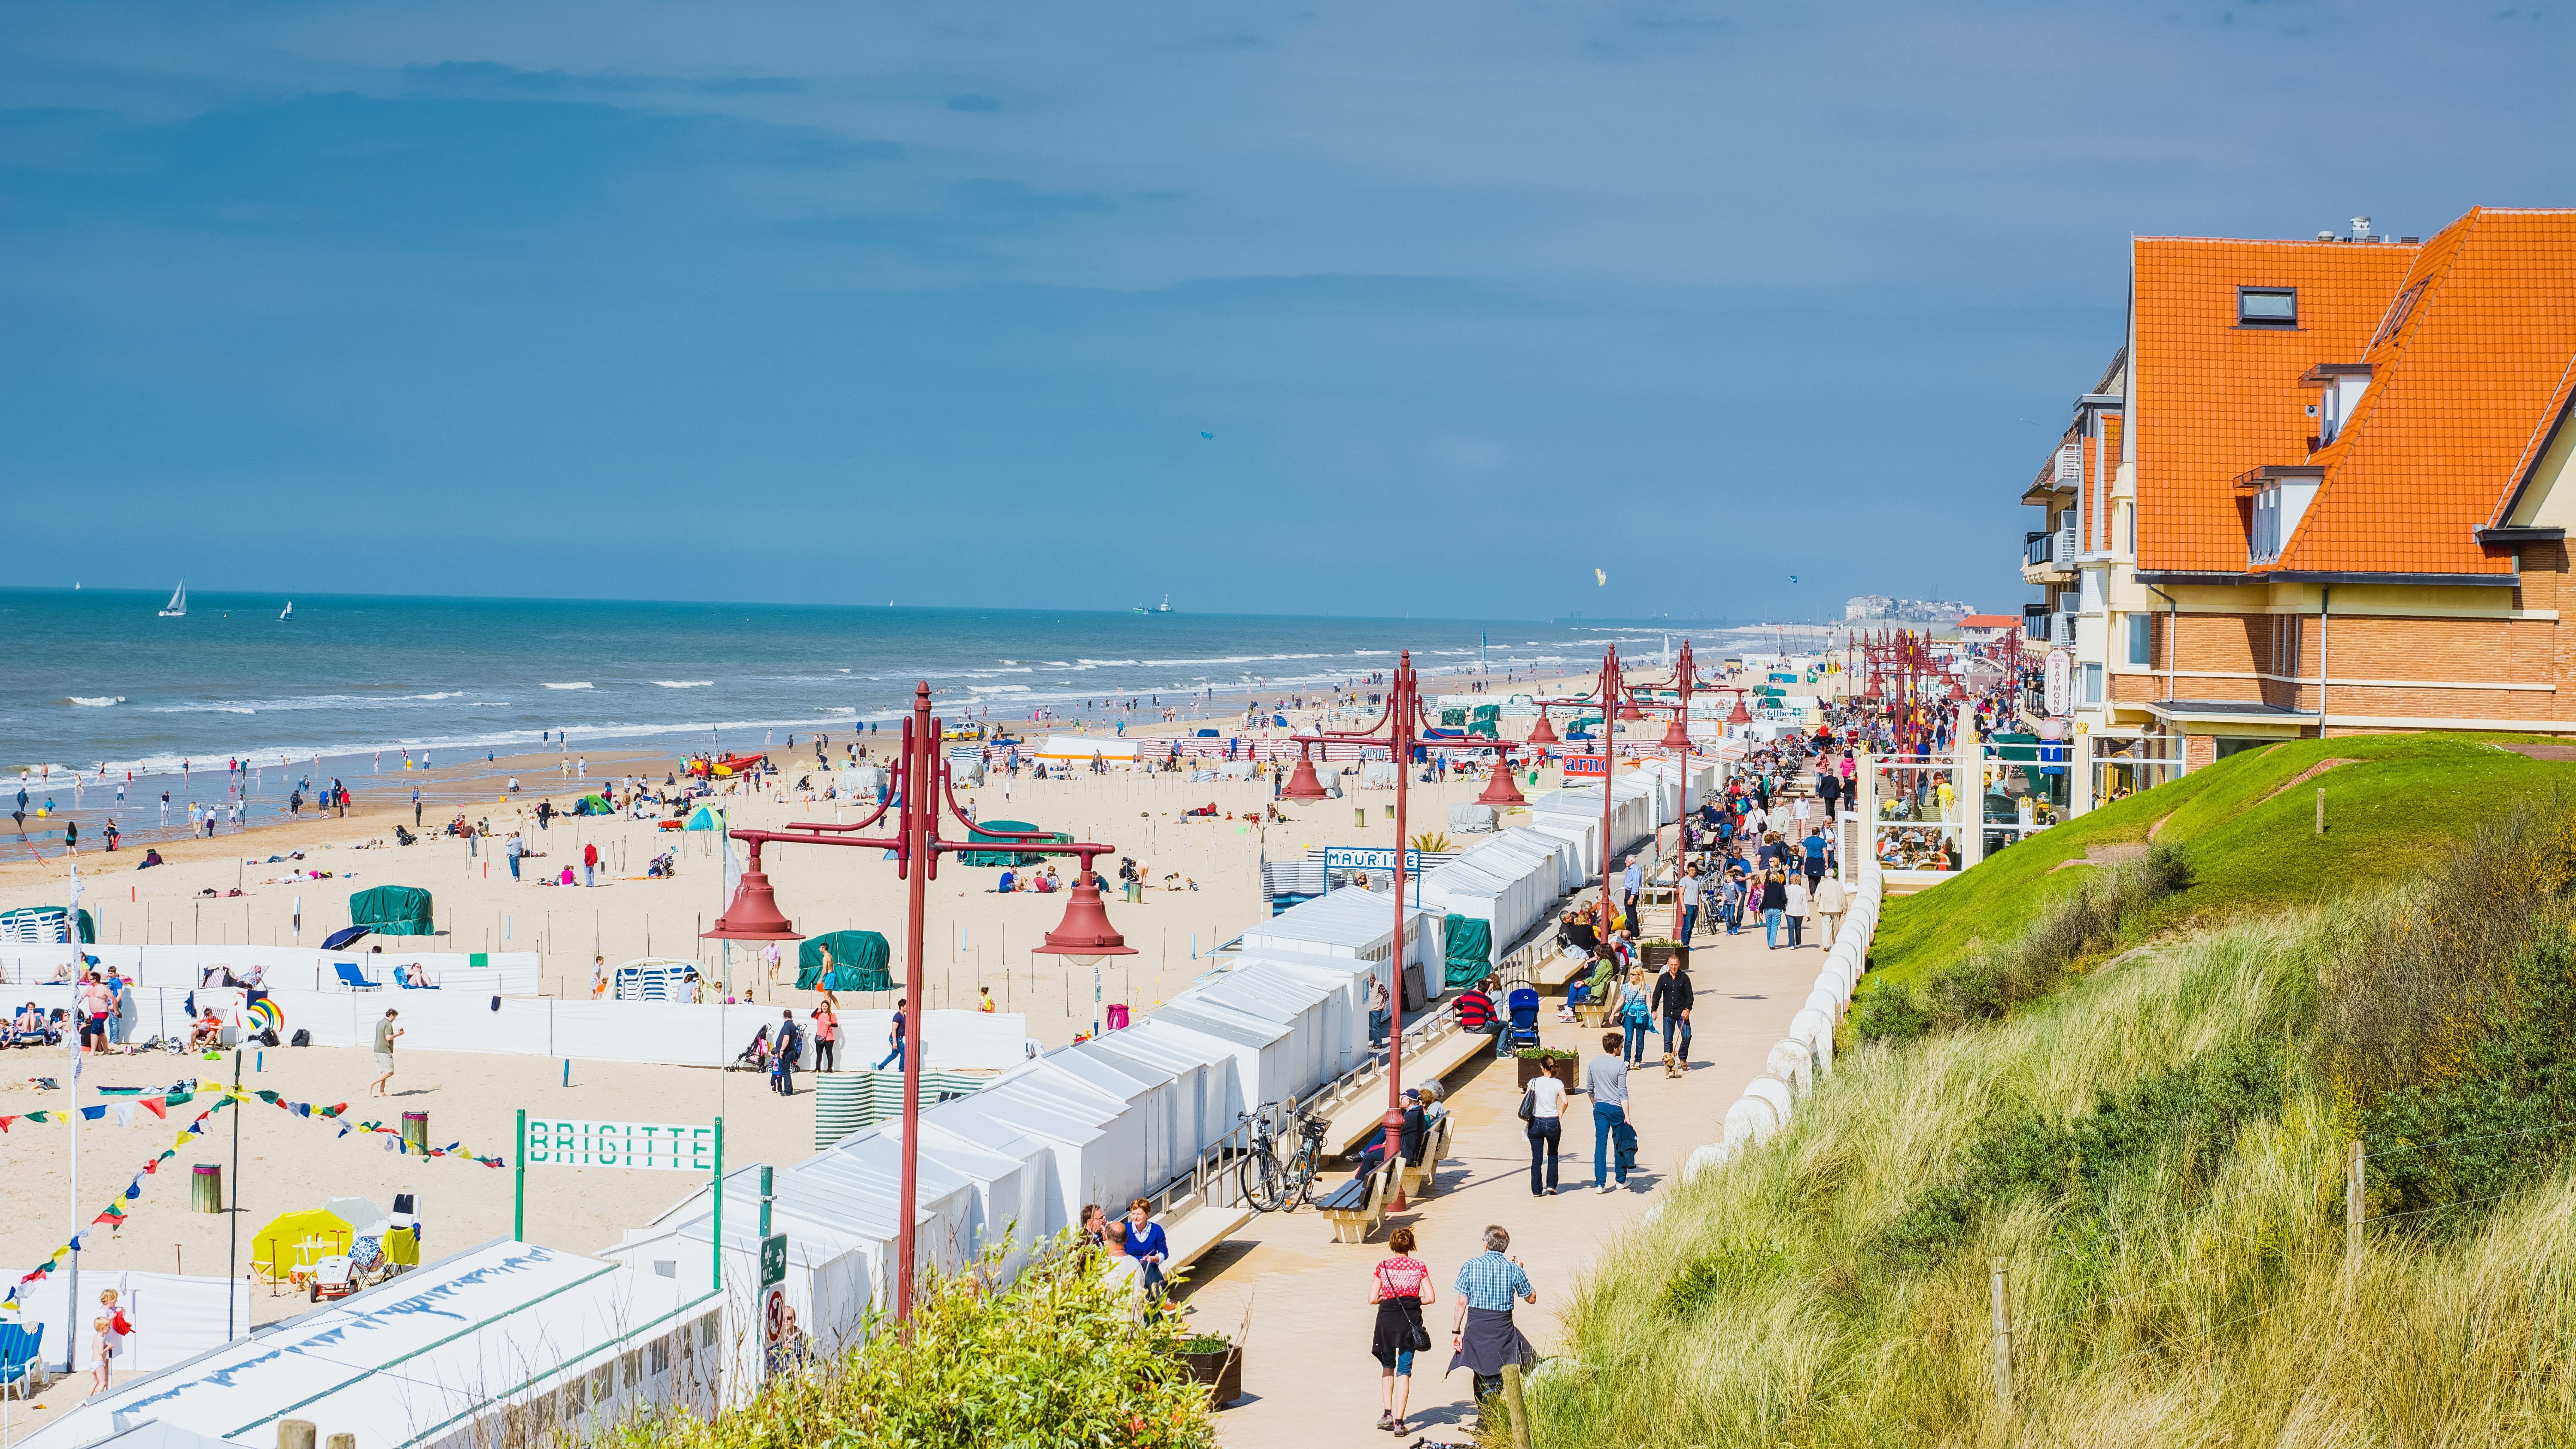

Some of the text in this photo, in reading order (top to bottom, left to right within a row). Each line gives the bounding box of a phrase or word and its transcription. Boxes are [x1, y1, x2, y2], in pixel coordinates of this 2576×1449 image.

[1329, 854, 1416, 867] MAURIE
[1792, 860, 1798, 869] 17
[531, 1121, 711, 1169] BRIGITTE
[762, 1267, 773, 1282] W.C.
